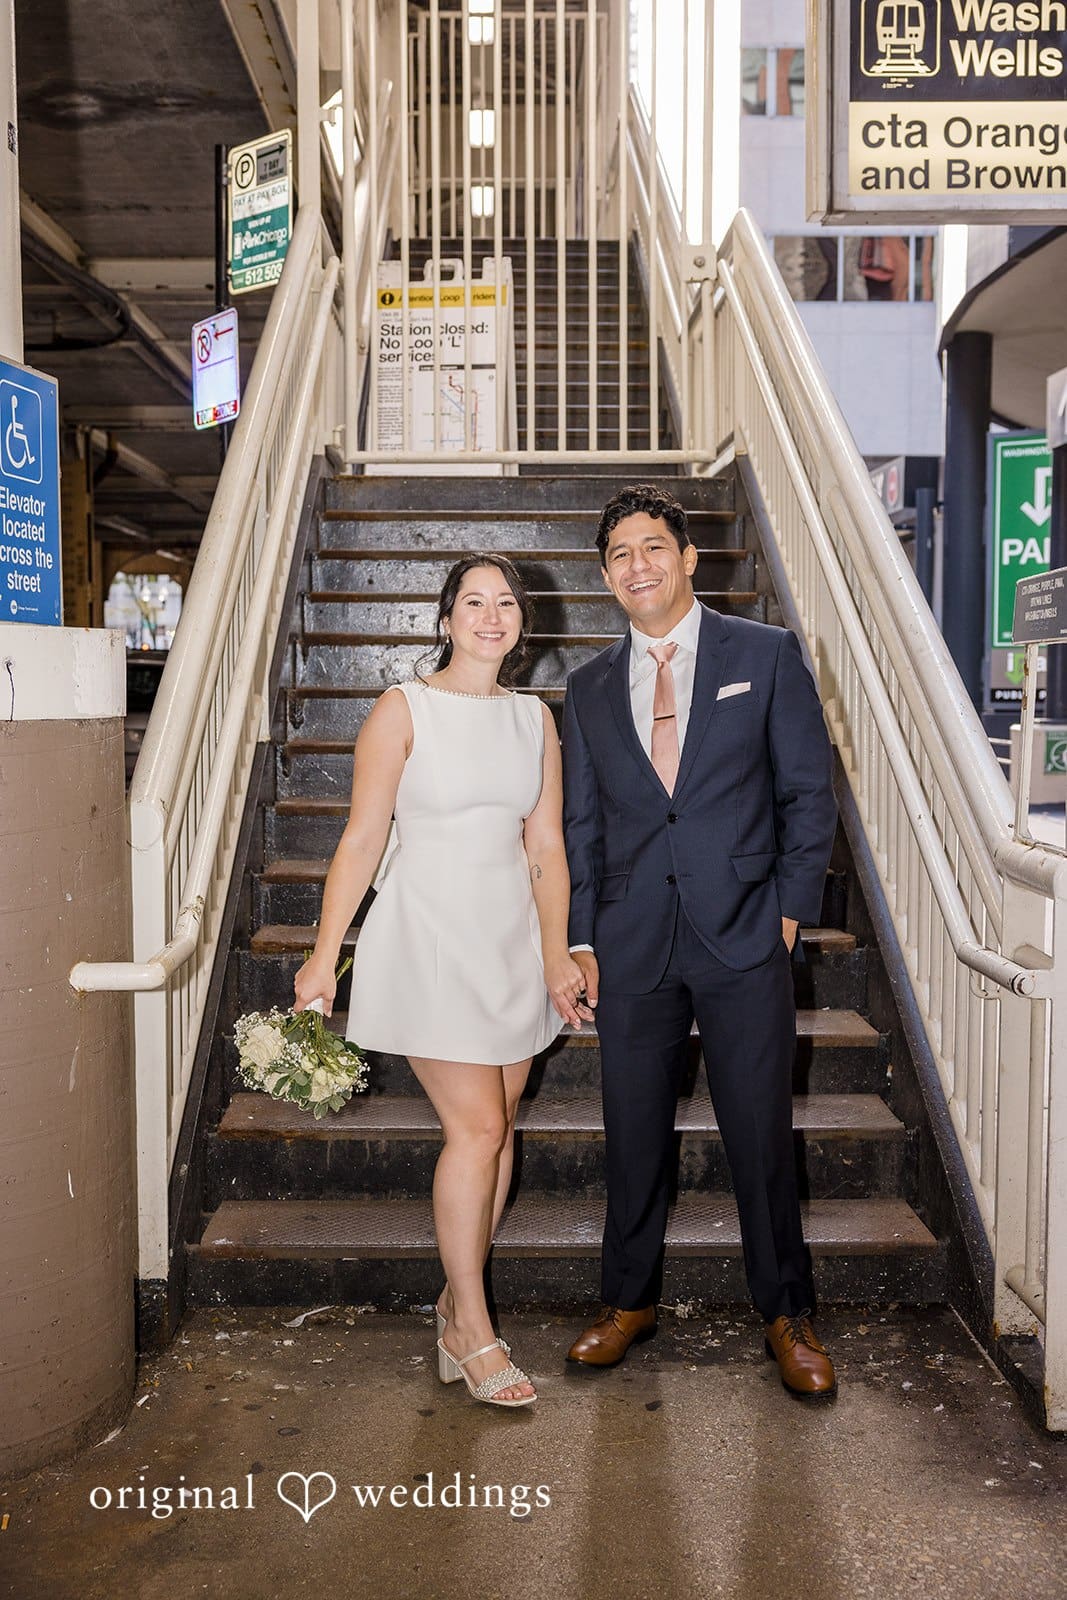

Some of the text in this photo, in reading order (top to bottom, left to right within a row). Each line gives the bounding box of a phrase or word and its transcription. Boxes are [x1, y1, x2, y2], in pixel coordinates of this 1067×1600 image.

[952, 0, 1066, 32] Wash
[949, 39, 1063, 77] Wells
[862, 114, 1067, 156] cta Orang
[861, 159, 1066, 190] and Brown
[245, 267, 263, 285] 512
[381, 323, 431, 336] Staion
[379, 337, 401, 349] No
[378, 350, 436, 363] serice
[0, 485, 46, 517] Elevator
[2, 513, 46, 542] located
[35, 547, 53, 569] the
[7, 570, 41, 593] street
